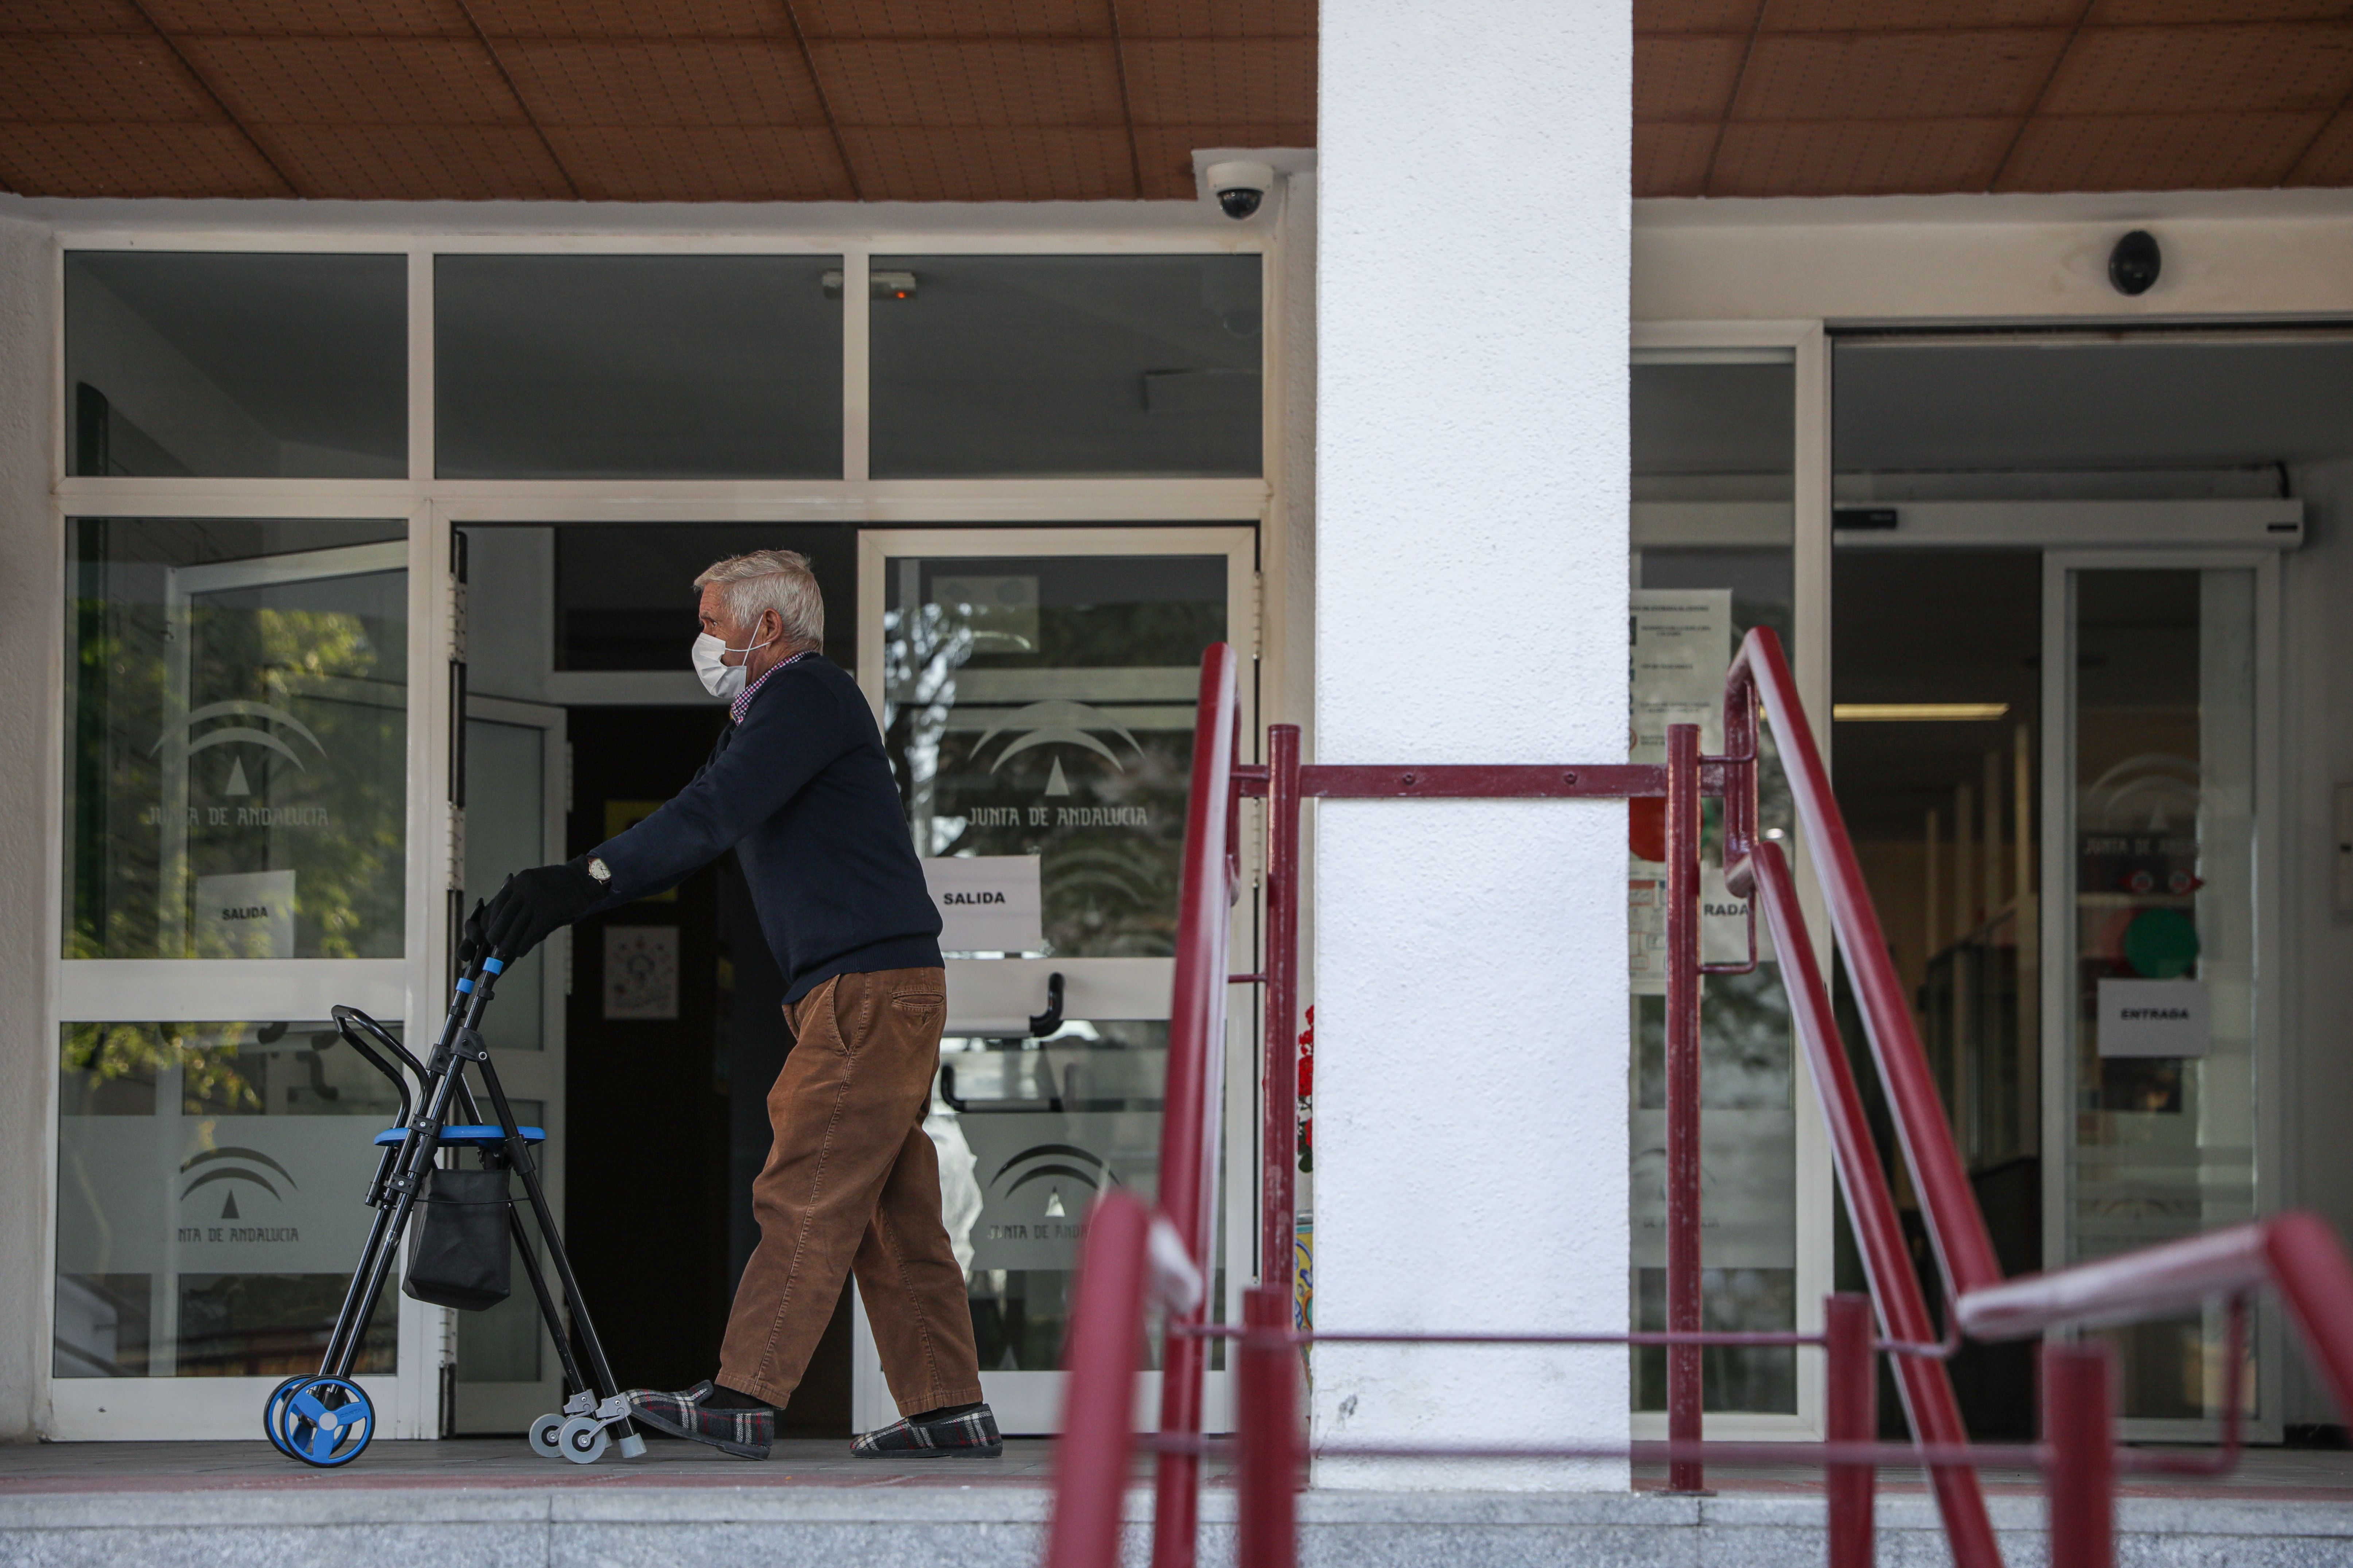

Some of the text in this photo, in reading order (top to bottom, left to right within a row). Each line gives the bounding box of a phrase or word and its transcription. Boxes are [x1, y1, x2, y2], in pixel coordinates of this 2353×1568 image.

[208, 807, 228, 826] DE
[238, 807, 328, 826] ANDALUCIA
[968, 807, 1148, 827] JUNTA DE ANDALUCIA
[944, 892, 1006, 905] SALIDA
[222, 906, 268, 920] SALIDA
[1704, 904, 1749, 916] RADA
[2121, 1008, 2189, 1020] ENTRADA
[178, 1228, 299, 1242] NTA DE ANDALUCIA
[1034, 1225, 1049, 1240] DE
